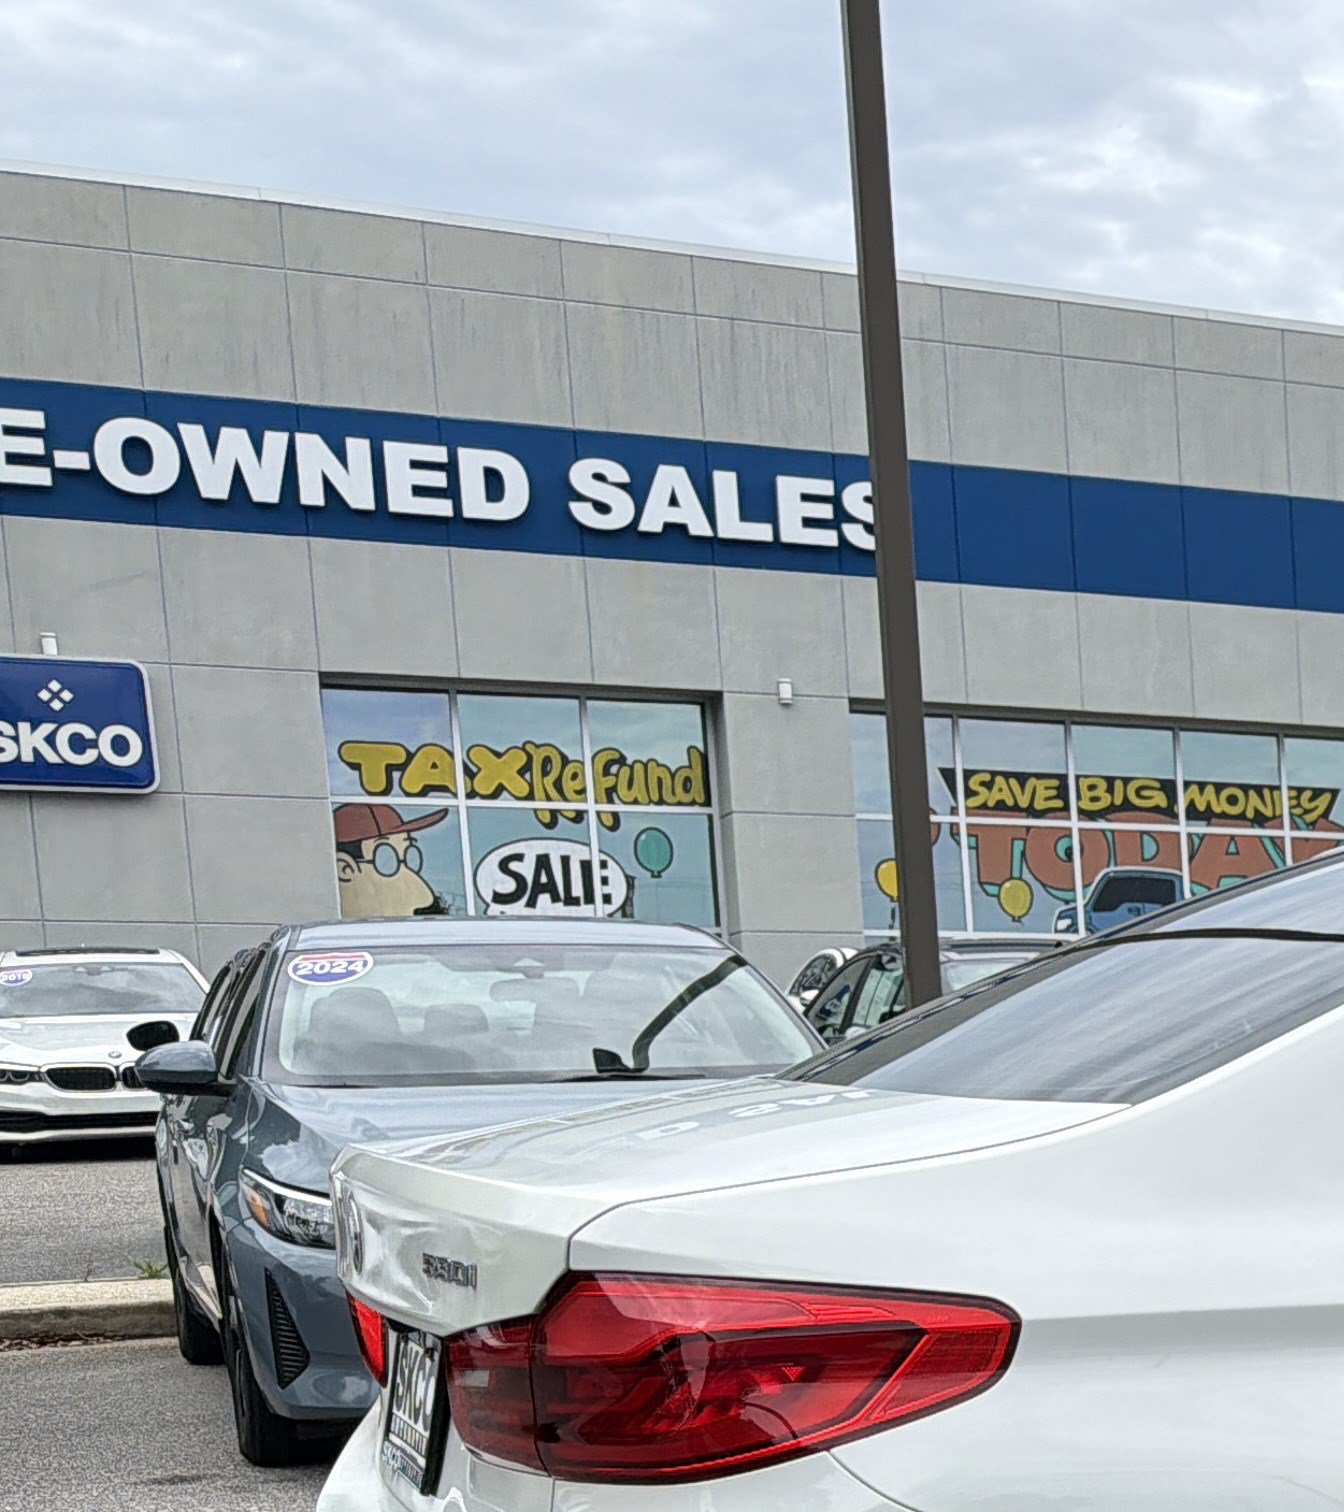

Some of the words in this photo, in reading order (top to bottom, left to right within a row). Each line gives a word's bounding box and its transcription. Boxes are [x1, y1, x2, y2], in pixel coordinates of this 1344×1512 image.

[0, 407, 530, 521] E-OWNED
[568, 458, 876, 551] SALES
[338, 741, 531, 797] TAX
[965, 773, 1065, 810] SAVE
[1078, 777, 1168, 809] BIG
[1174, 783, 1333, 822] MONEY
[491, 853, 612, 908] SALE
[296, 960, 365, 976] 2024
